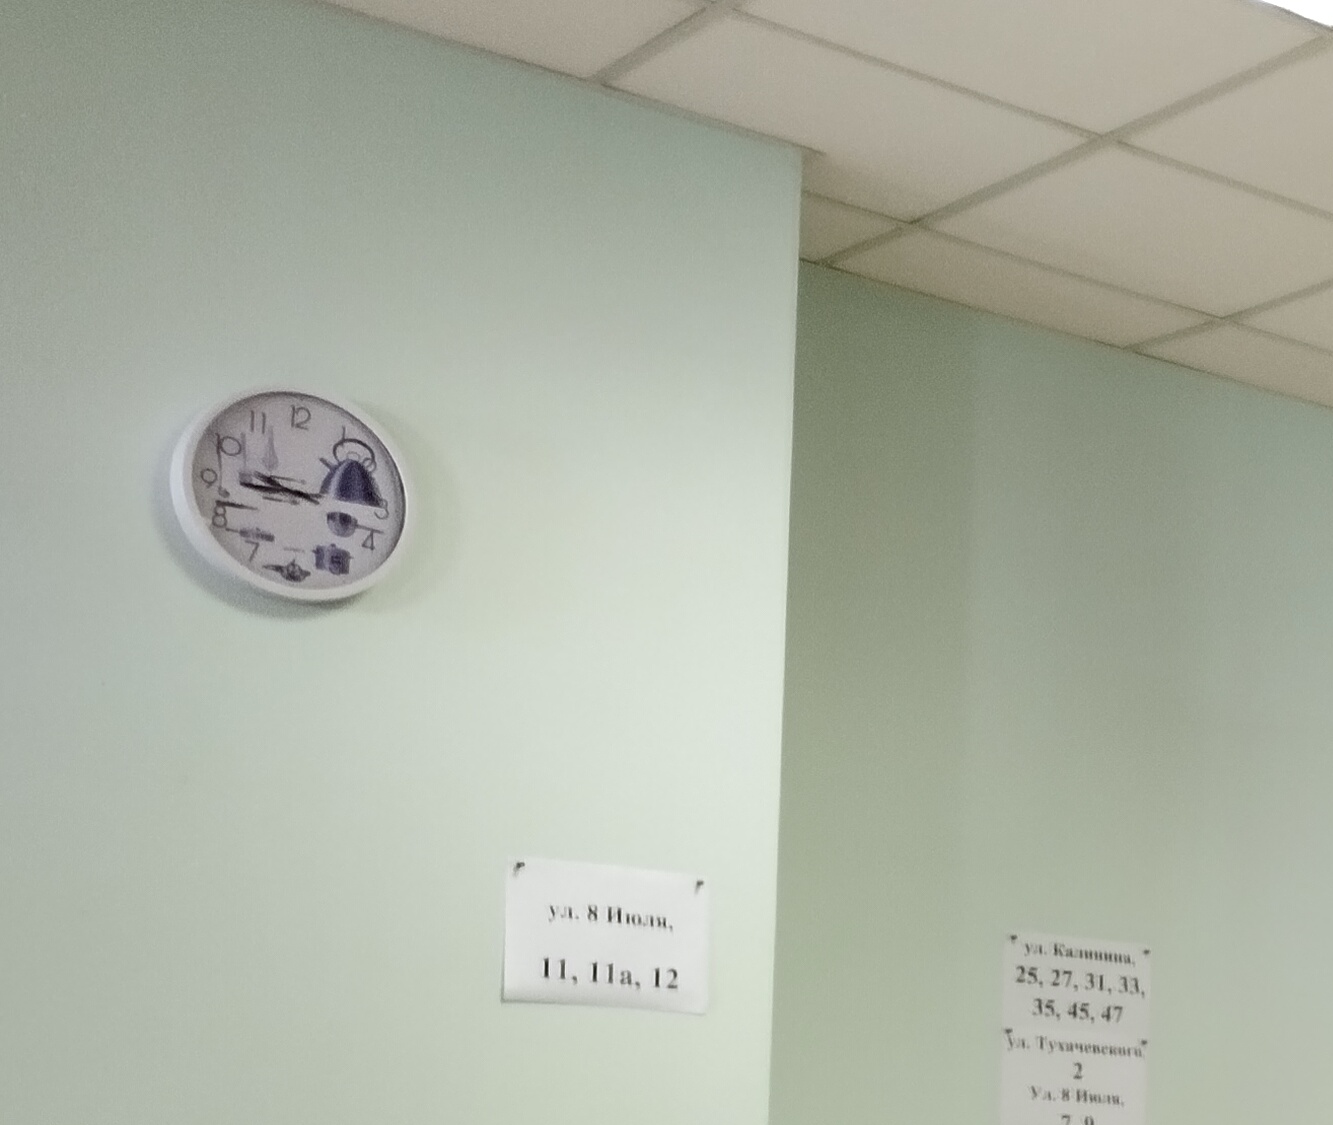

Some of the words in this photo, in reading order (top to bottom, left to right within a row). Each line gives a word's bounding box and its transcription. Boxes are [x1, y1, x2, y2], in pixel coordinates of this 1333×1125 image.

[250, 410, 266, 434] 11
[291, 405, 311, 430] 12
[201, 468, 217, 488] 9
[212, 504, 227, 528] 8
[245, 540, 259, 561] 7
[549, 905, 579, 922] ул.
[587, 904, 598, 921] 8
[607, 906, 673, 932] Июля,
[543, 958, 577, 984] 11,
[591, 962, 641, 989] 11а,
[654, 968, 678, 988] 12
[1016, 966, 1043, 987] 25,
[1051, 969, 1078, 991] 27,
[1085, 973, 1111, 994] 31,
[1119, 976, 1145, 998] 33,
[1032, 999, 1060, 1020] 35,
[1068, 1003, 1094, 1023] 45,
[1101, 1006, 1123, 1023] 47
[1073, 1062, 1083, 1079] 2
